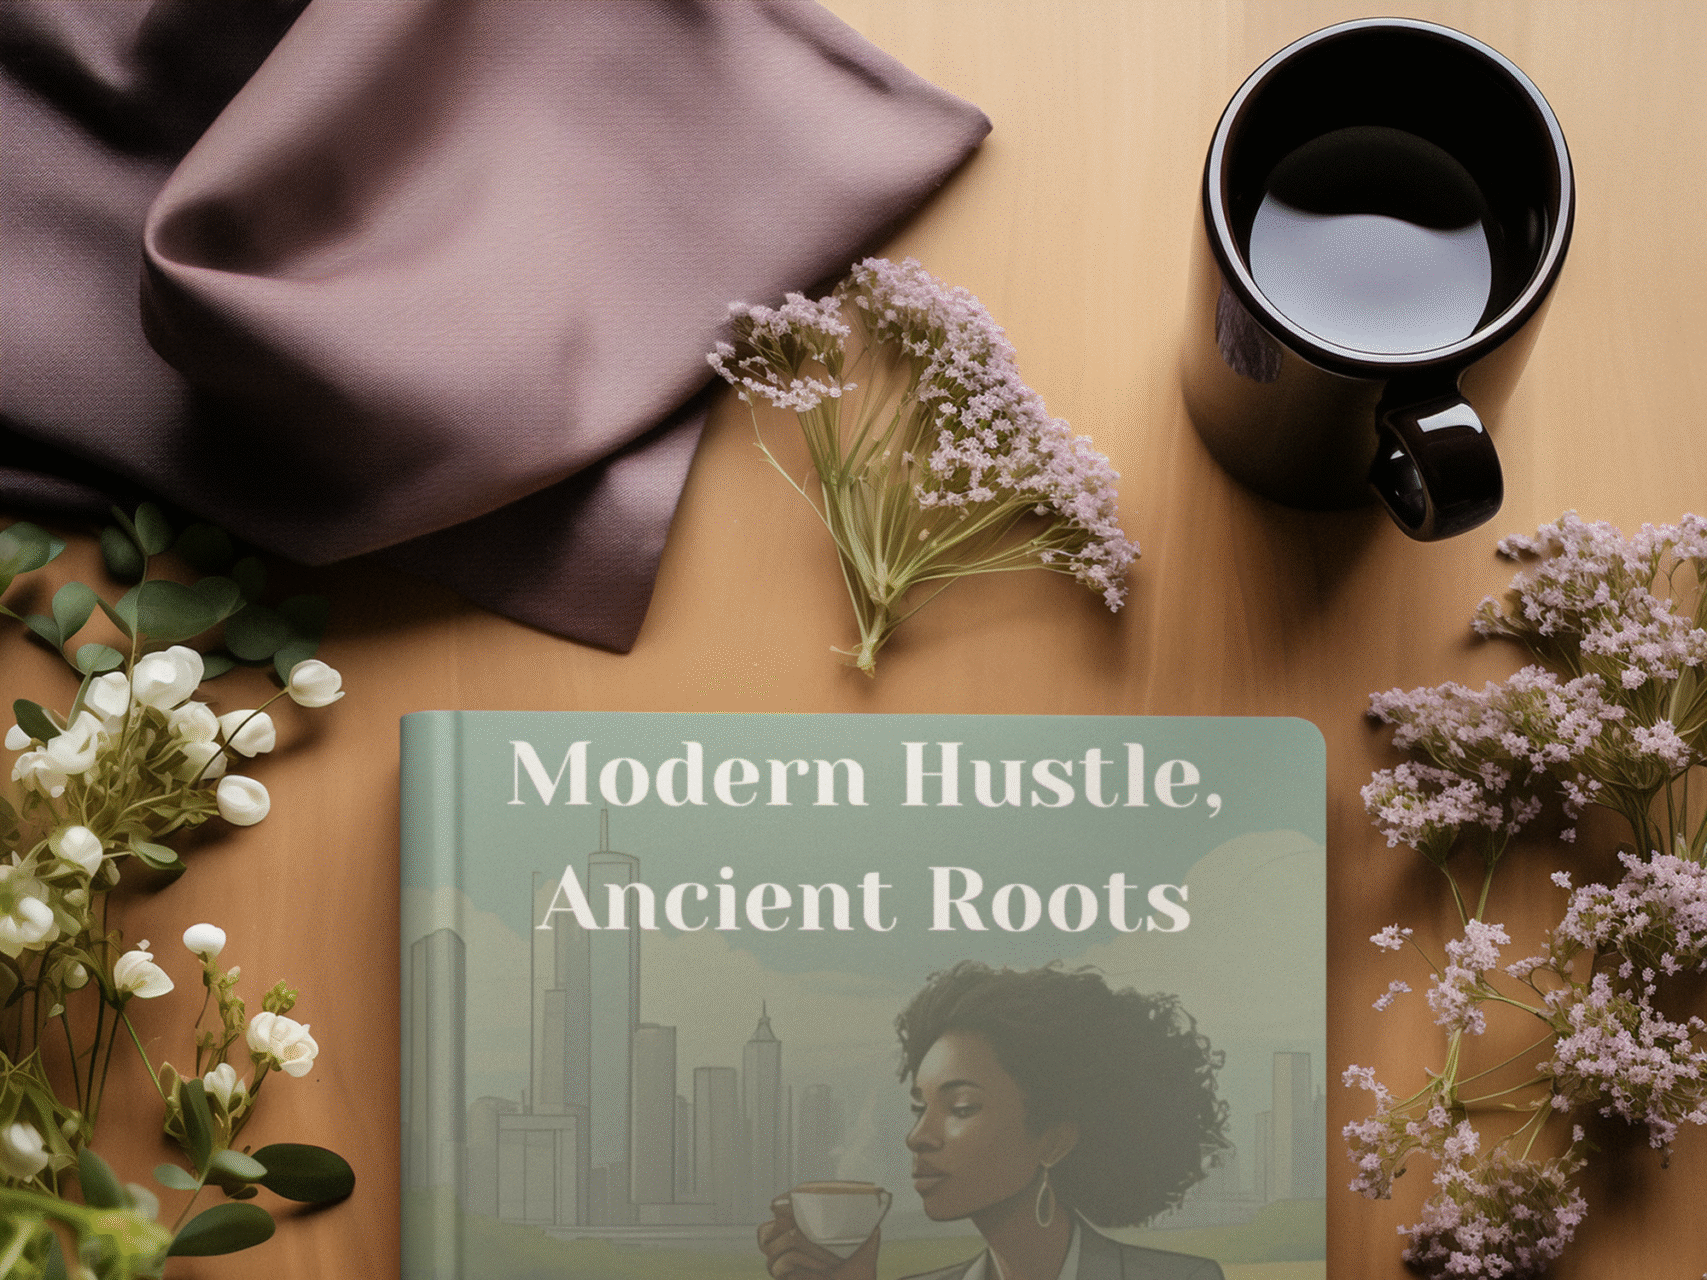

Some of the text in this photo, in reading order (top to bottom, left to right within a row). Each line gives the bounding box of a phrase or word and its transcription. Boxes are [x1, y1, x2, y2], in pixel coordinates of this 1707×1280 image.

[507, 740, 1223, 818] Modern Hustle,
[535, 864, 1191, 933] Ancient Roots
